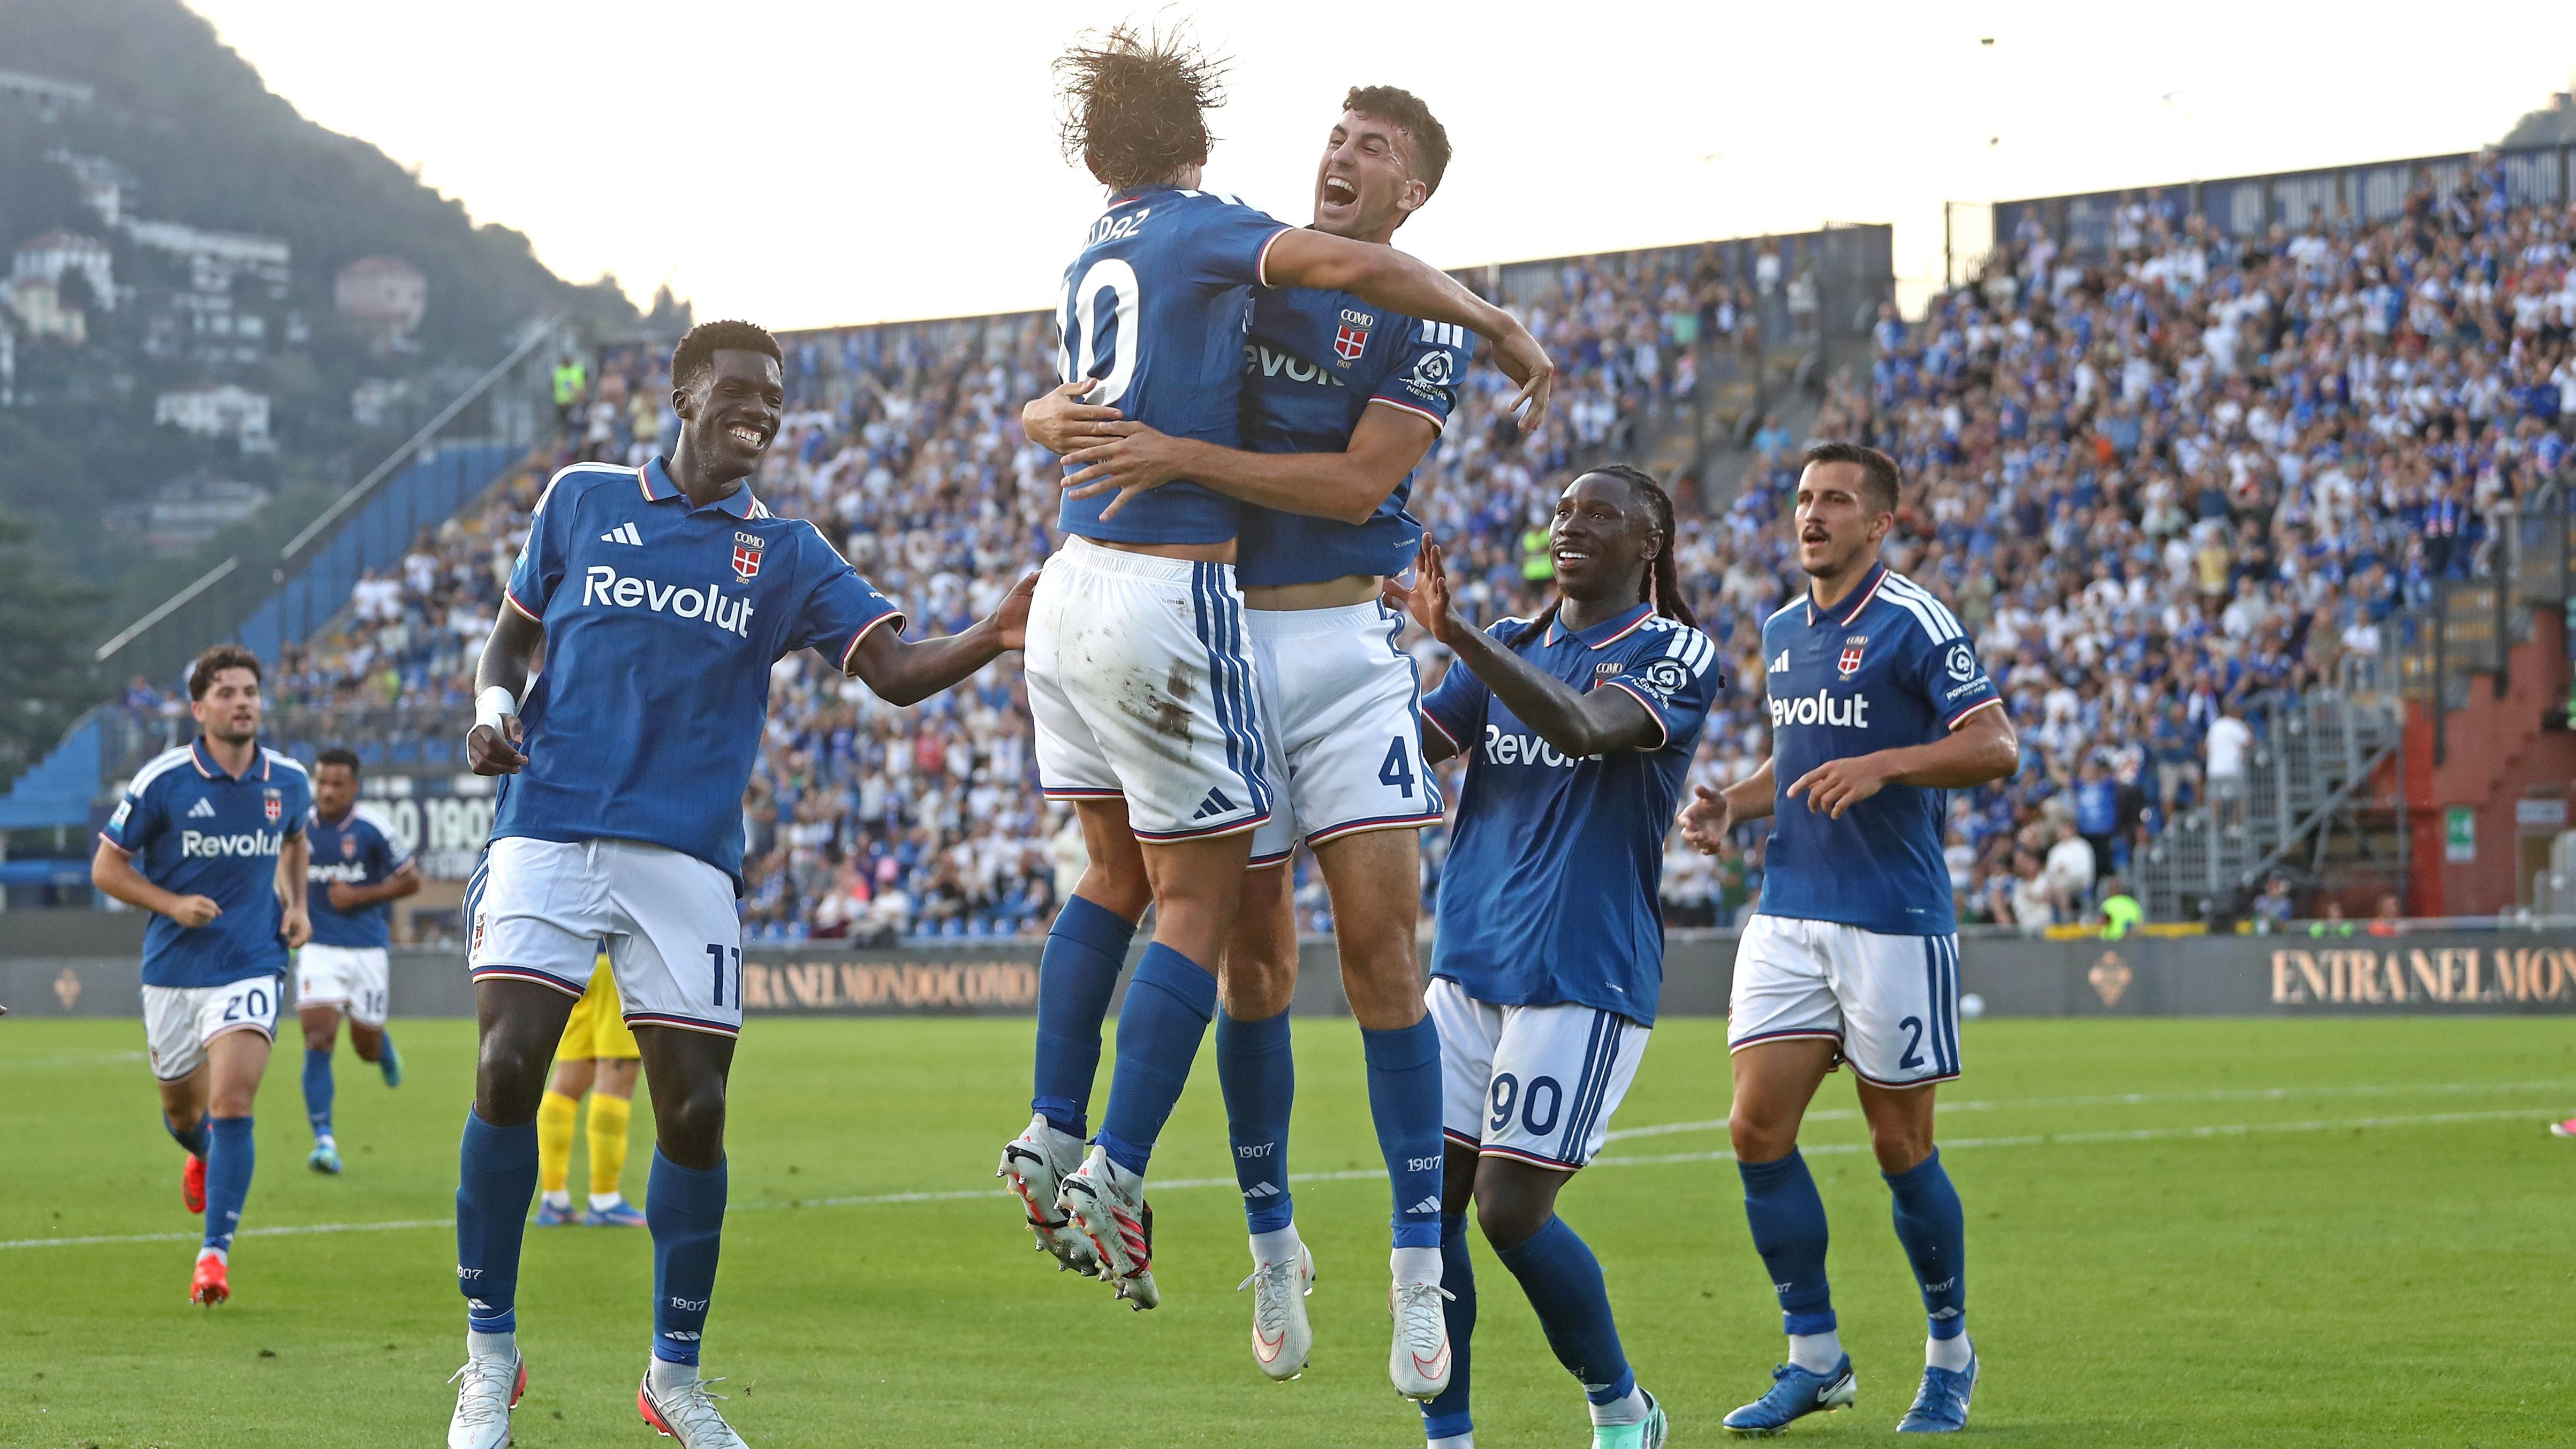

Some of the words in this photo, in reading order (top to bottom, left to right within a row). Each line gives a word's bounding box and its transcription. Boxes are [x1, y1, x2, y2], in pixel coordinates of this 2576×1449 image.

[1340, 309, 1374, 327] COMO
[1337, 359, 1351, 369] 1907
[734, 531, 765, 548] COMO
[736, 575, 750, 585] 1907
[582, 565, 754, 639] Revolut
[1596, 663, 1623, 674] COMO
[1767, 688, 1869, 729] evolut
[1378, 735, 1415, 798] 4
[707, 944, 740, 1010] 11
[224, 989, 268, 1021] 20
[1898, 1016, 1925, 1069] 2
[1490, 1073, 1563, 1136] 90
[1238, 1142, 1274, 1158] 1907
[1407, 1155, 1442, 1172] 1907
[670, 1296, 707, 1311] 1907
